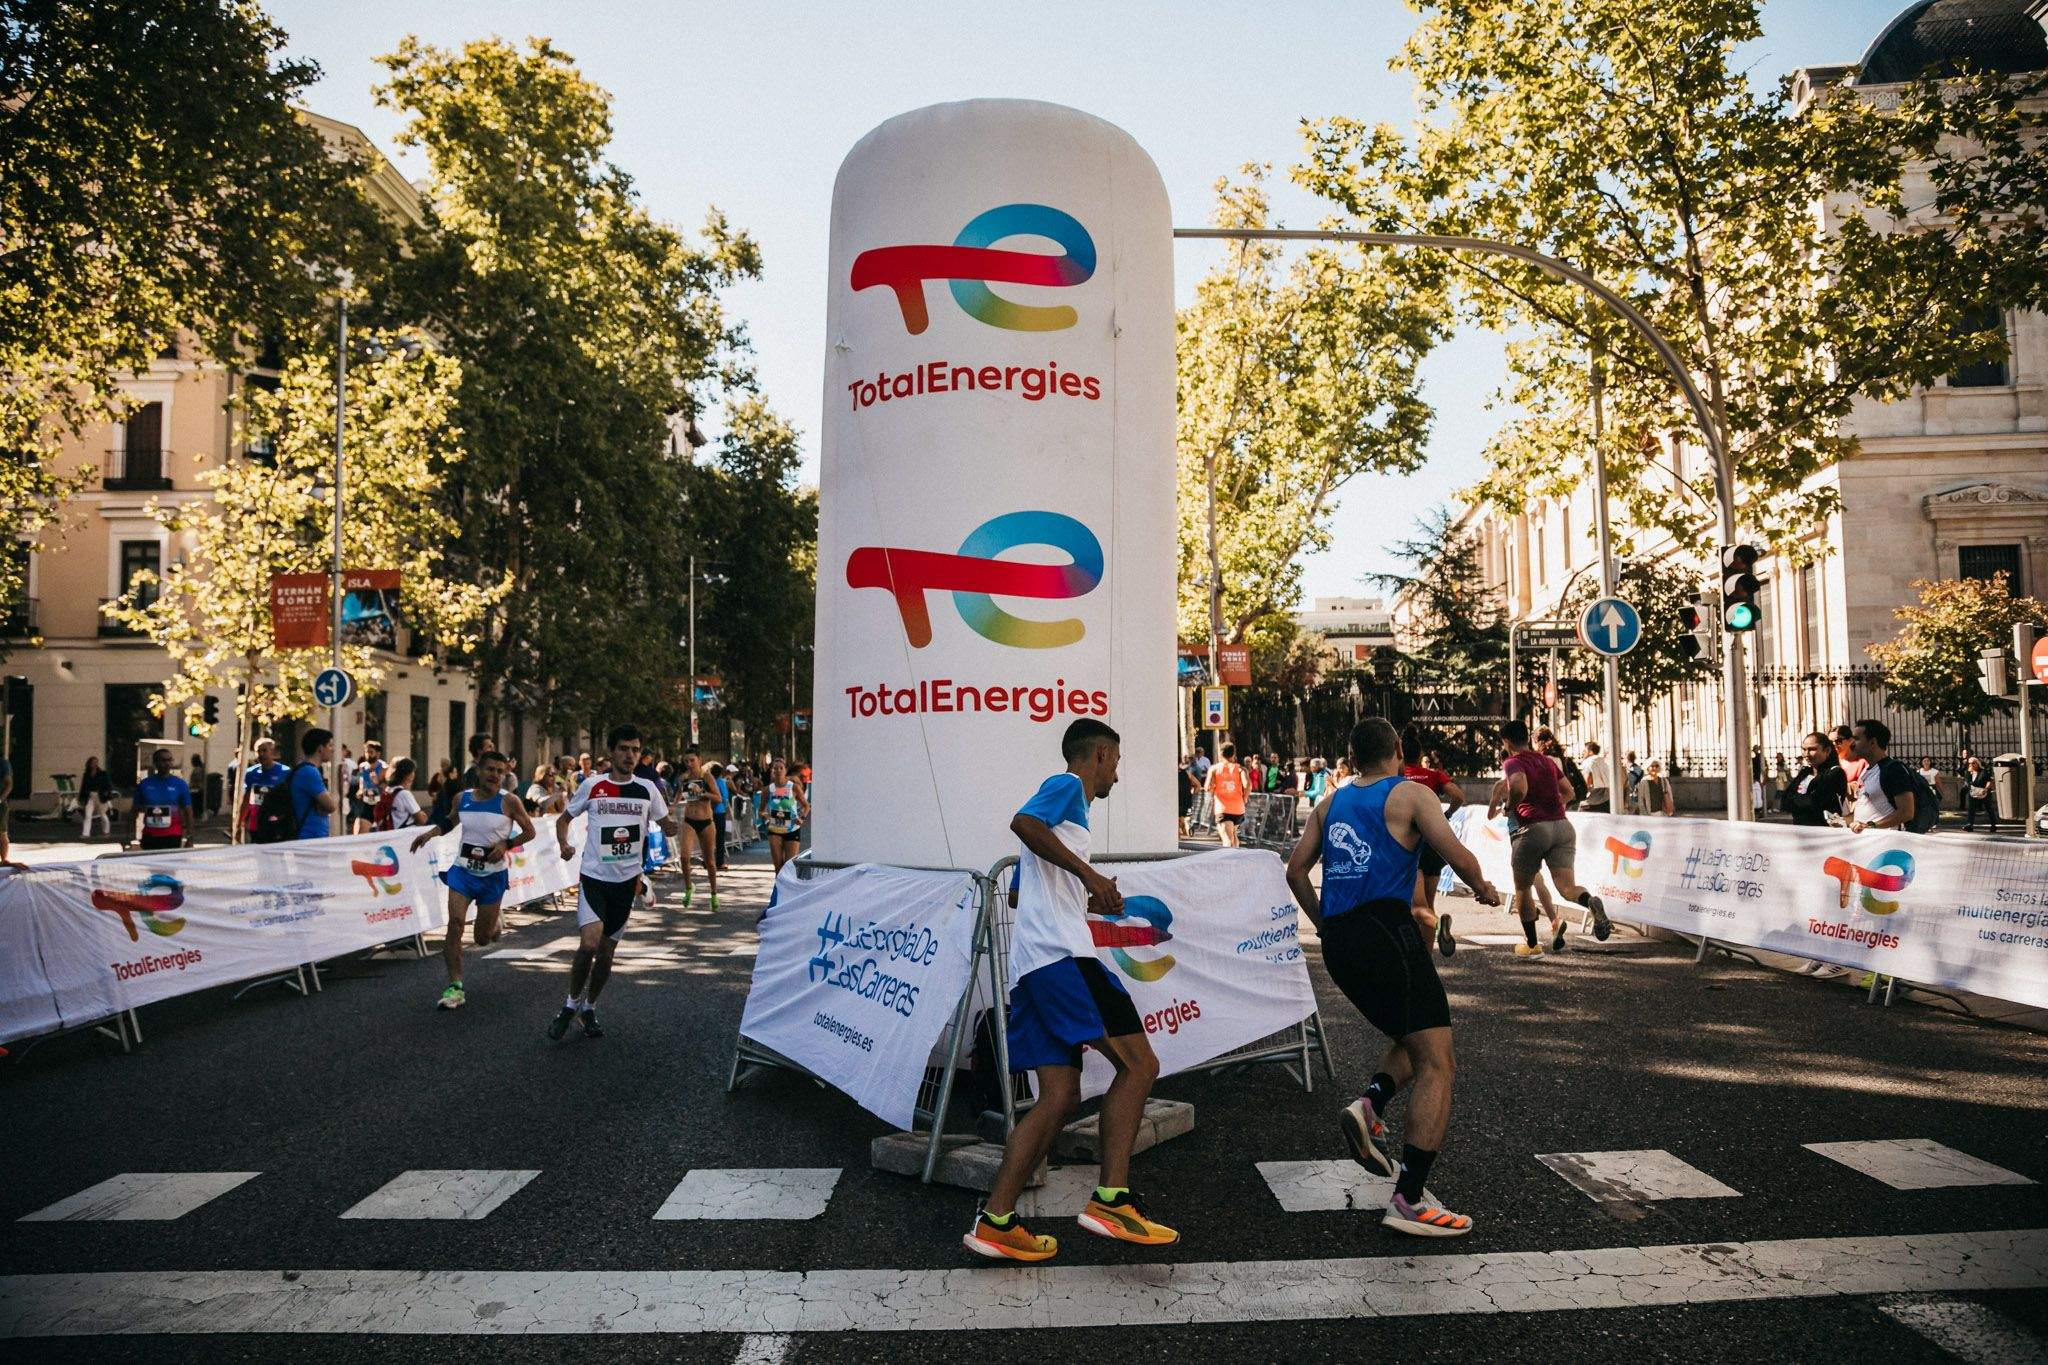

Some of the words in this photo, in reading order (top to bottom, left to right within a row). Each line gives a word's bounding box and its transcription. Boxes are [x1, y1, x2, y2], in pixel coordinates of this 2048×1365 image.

[848, 361, 1101, 411] TotalEnergies
[845, 679, 1108, 723] TotalEnergies
[611, 843, 632, 856] 582
[1995, 888, 2037, 905] Somos
[1808, 918, 1900, 949] TotalEnergies
[1978, 928, 1998, 942] tus
[111, 947, 202, 981] TotalEnergies
[813, 1011, 874, 1052] totalenergies.es
